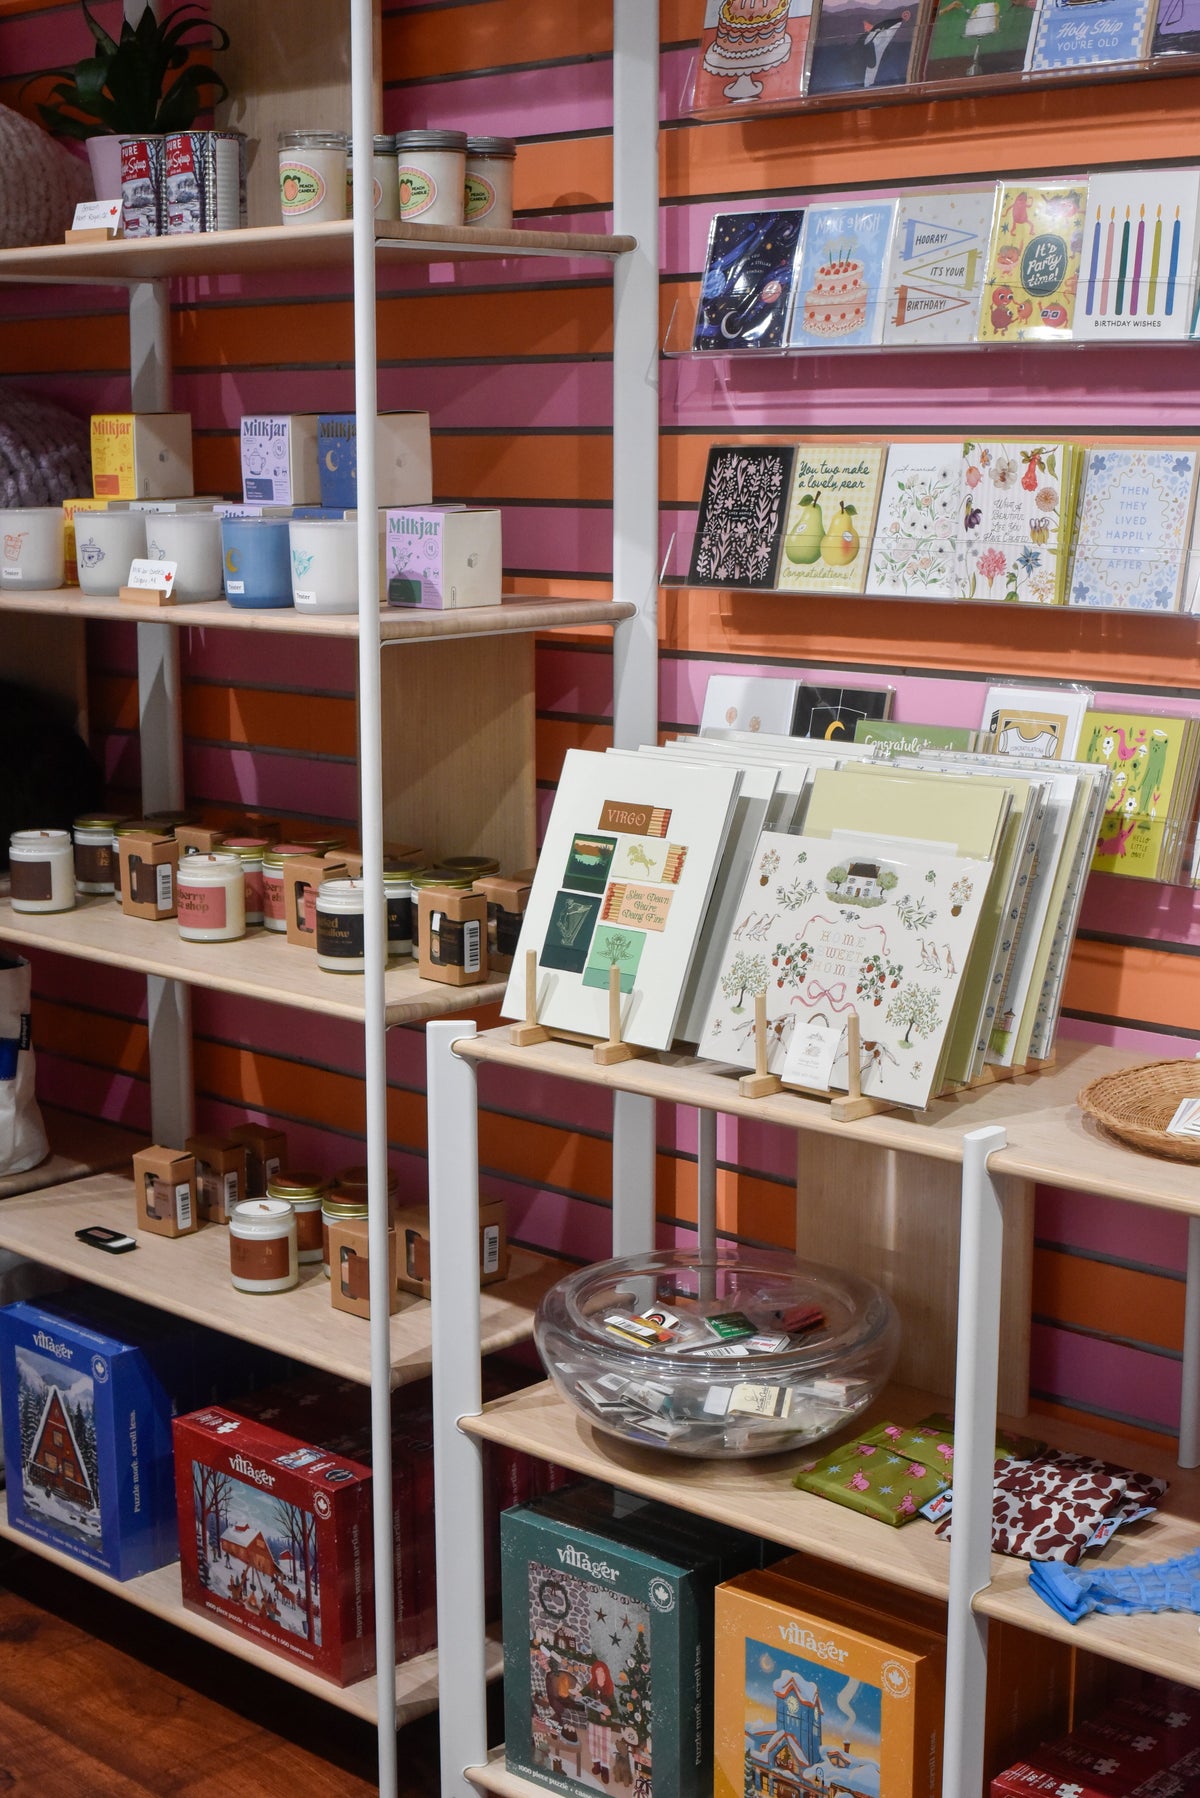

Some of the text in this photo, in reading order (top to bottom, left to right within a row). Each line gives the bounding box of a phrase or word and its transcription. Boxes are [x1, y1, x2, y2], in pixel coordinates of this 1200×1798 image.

[1056, 19, 1123, 40] Holy Ship
[1057, 37, 1119, 51] YOU'RE OLD
[816, 215, 845, 234] MAKE
[854, 213, 882, 233] WISH
[915, 234, 948, 245] HOORAY!
[1035, 243, 1057, 257] It's
[930, 267, 965, 277] IT'S YOUR
[1027, 255, 1062, 274] Party
[1027, 269, 1058, 287] time!
[906, 300, 946, 311] BIRTHDAY!
[93, 419, 131, 439] Milkjar
[243, 419, 287, 441] Milkjar
[320, 420, 356, 442] Milkja
[798, 460, 870, 478] You two make
[798, 475, 866, 491] a lovely pear
[1121, 486, 1149, 495] THEN
[1119, 501, 1147, 510] THEY
[389, 516, 440, 540] Milkjar
[1115, 516, 1147, 525] LIVED
[1106, 530, 1152, 540] HAPPILY
[1112, 545, 1140, 554] EVER
[1107, 560, 1143, 569] AFTER
[782, 567, 855, 581] Congratulations!
[608, 809, 646, 826] VIRGO
[1130, 843, 1149, 851] LITTLE
[185, 901, 209, 913] shop
[647, 893, 671, 905] Down
[32, 1331, 73, 1359] villager
[228, 1454, 275, 1487] villager
[133, 1484, 141, 1512] Puzzle
[557, 1545, 620, 1580] villager
[778, 1622, 848, 1663] villager
[518, 1764, 569, 1790] 1000 piece puzzle
